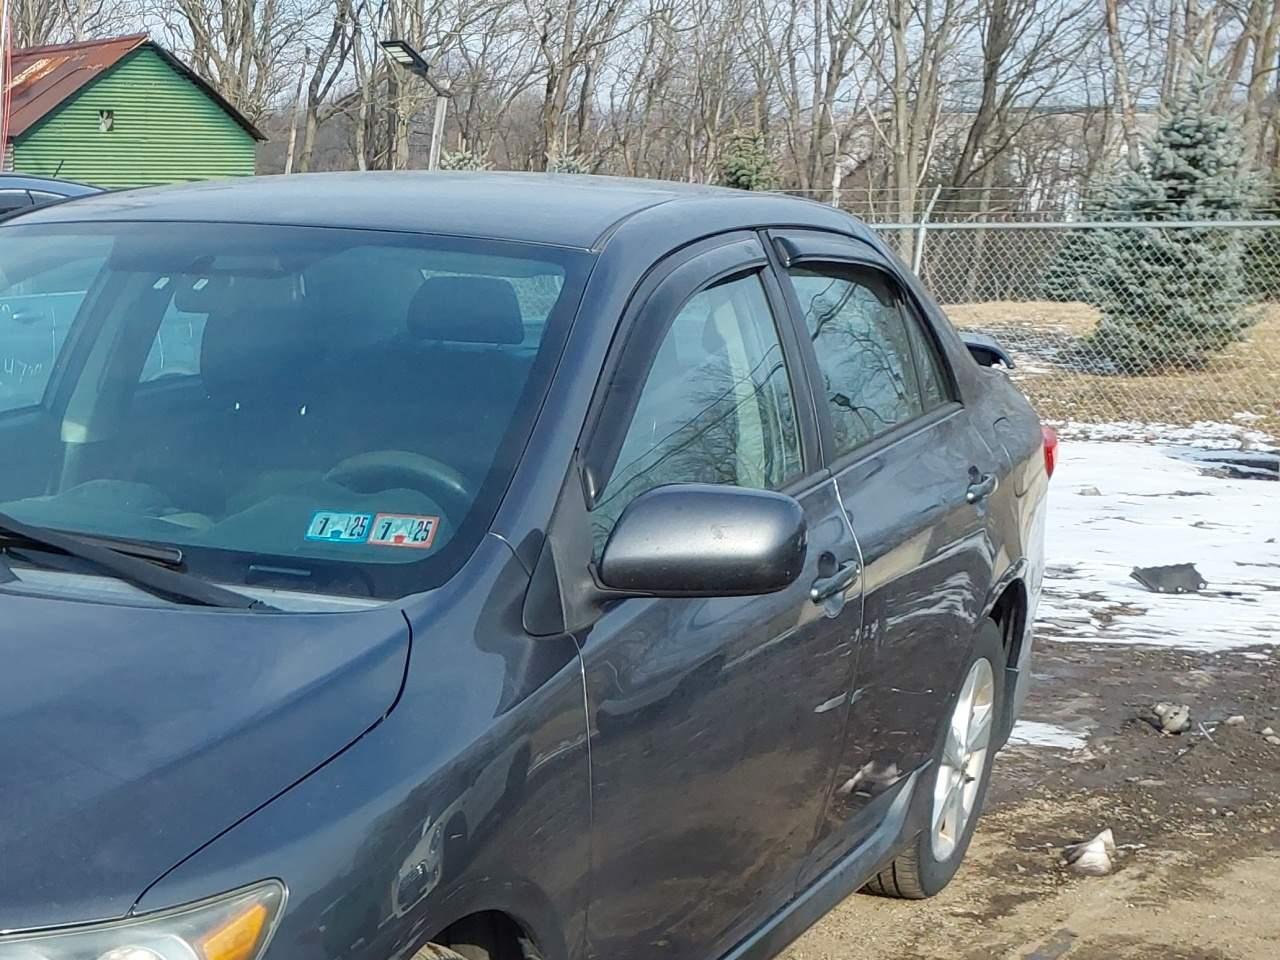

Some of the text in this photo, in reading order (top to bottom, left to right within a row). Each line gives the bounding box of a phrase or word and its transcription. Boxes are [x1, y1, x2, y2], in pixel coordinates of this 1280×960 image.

[319, 516, 369, 537] 7 25
[381, 520, 433, 542] 7 25
